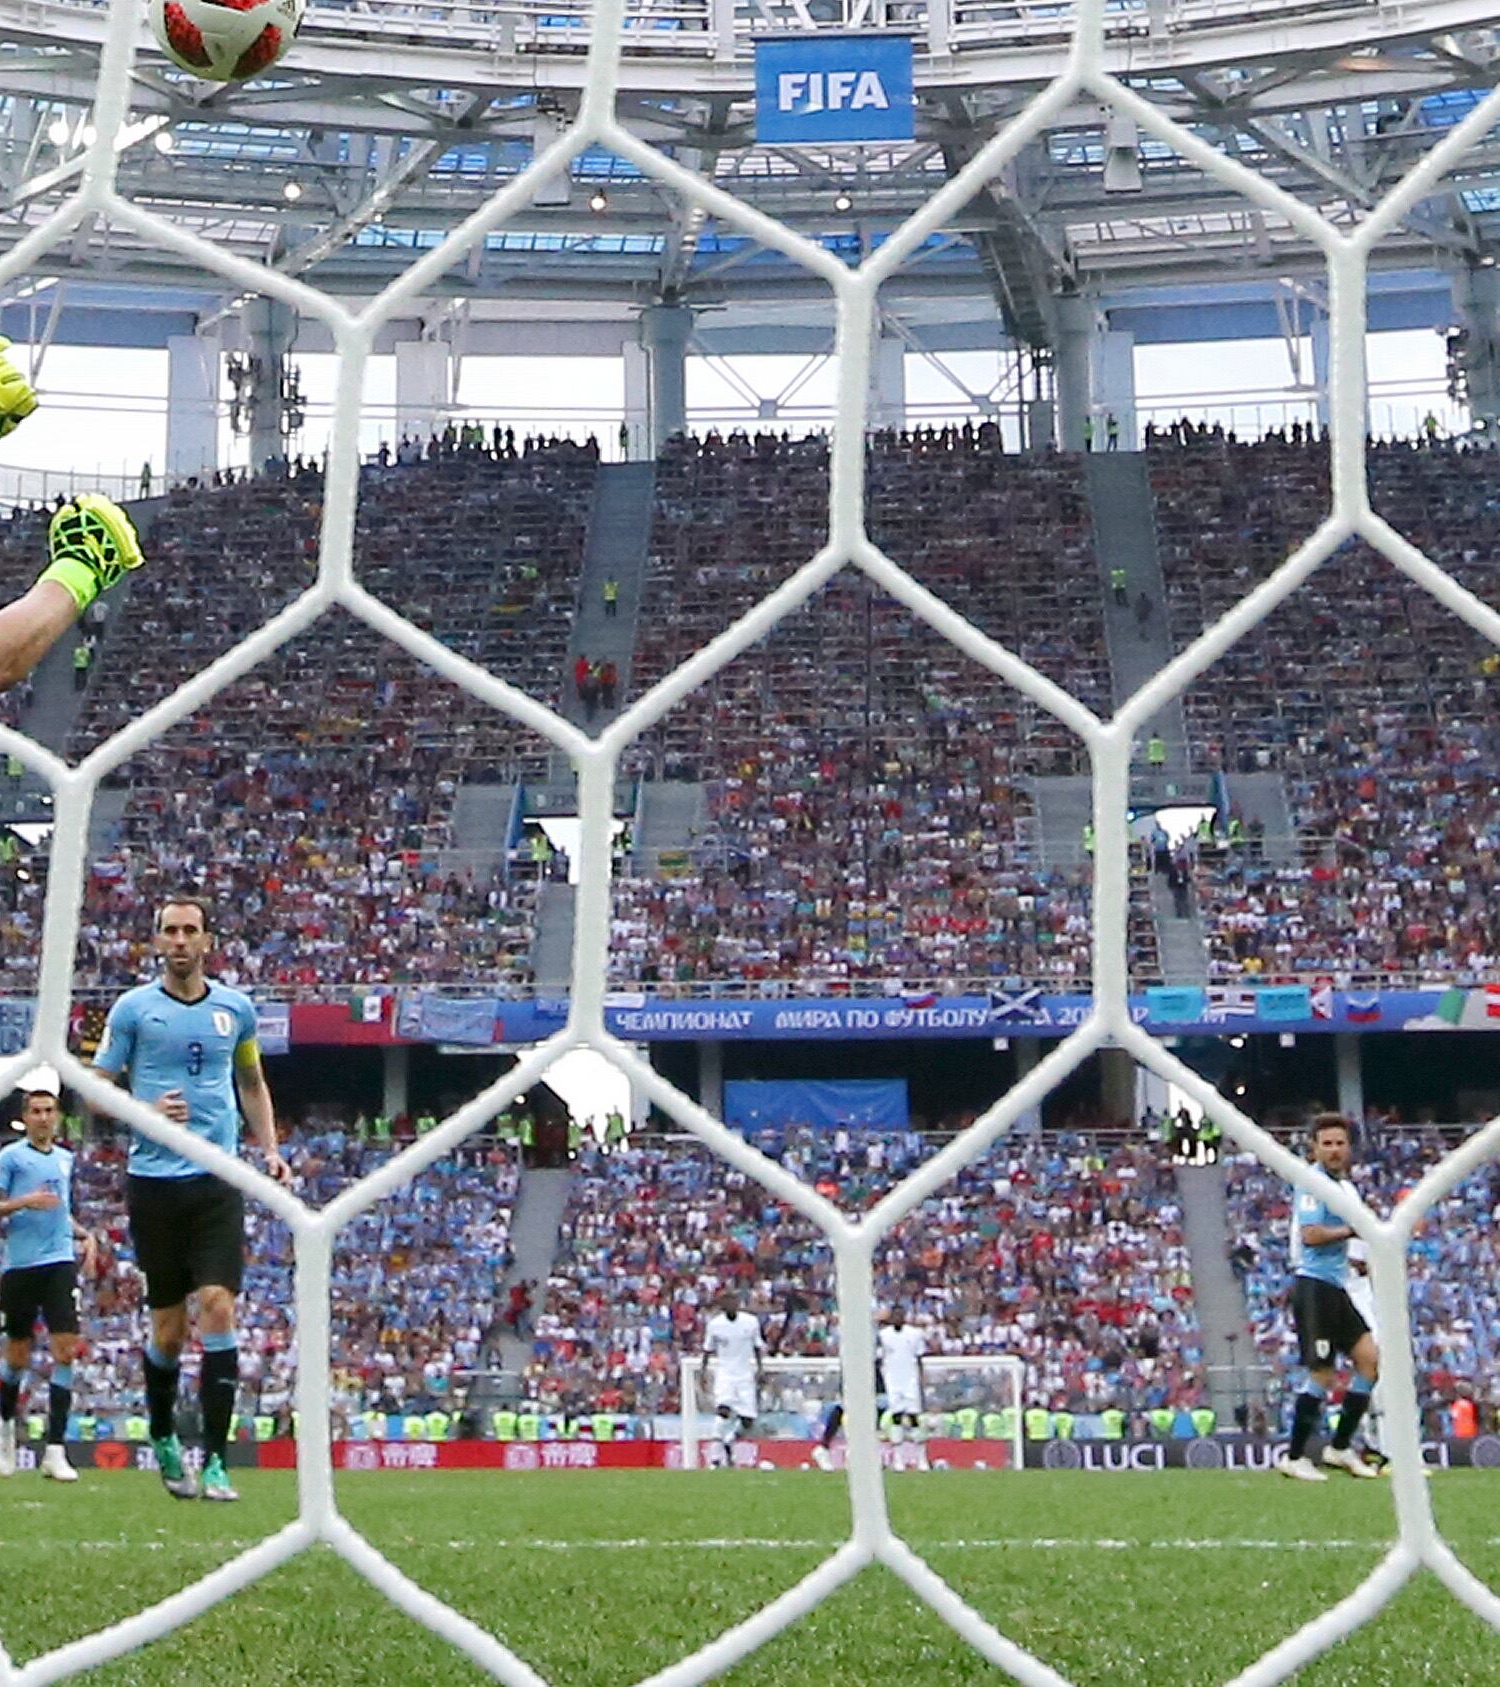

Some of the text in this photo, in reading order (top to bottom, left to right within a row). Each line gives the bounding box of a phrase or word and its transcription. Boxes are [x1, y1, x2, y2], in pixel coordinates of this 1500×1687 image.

[778, 72, 889, 112] FIFA
[614, 1010, 753, 1032] ЧЕМПИОНАТ
[774, 1009, 842, 1029] МИРА
[846, 1009, 879, 1029] ПО
[884, 1006, 988, 1029] ФУТБОЛУ
[187, 1041, 204, 1077] 3
[1083, 1443, 1165, 1471] LUCI
[1225, 1443, 1291, 1471] LUC
